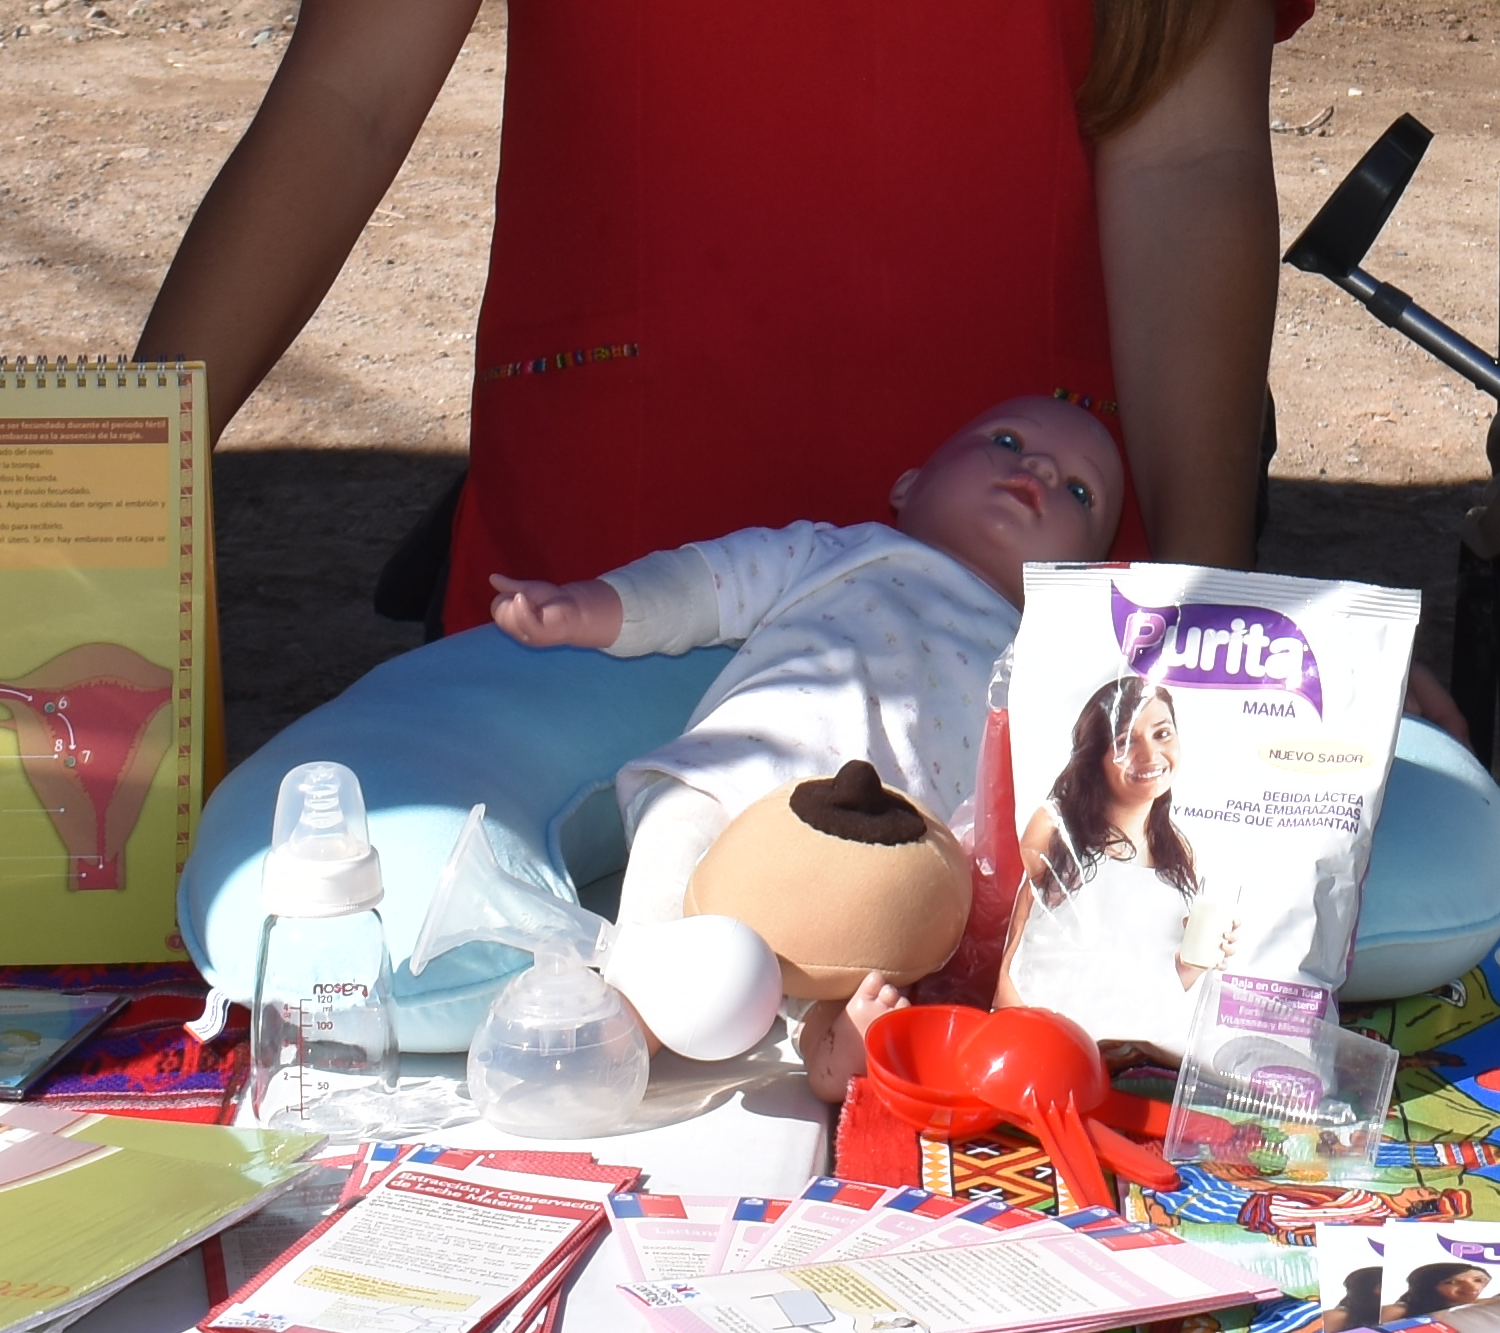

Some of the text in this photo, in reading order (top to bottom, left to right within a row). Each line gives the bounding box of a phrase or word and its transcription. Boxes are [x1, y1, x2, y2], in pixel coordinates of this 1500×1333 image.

[1121, 612, 1306, 685] Purita
[1242, 700, 1296, 718] MAMÁ
[1268, 748, 1315, 762] NUEVO
[1262, 790, 1365, 806] BEBIDA LÁCTEA
[1226, 799, 1362, 821] PARA EMBARAZADAS
[1183, 806, 1359, 835] MADRES QUE AMAMANTAN
[317, 995, 333, 1004] 120
[317, 1021, 333, 1030] 100
[317, 1081, 330, 1091] 50
[390, 1179, 534, 1212] de Leche Materna
[400, 1171, 603, 1212] Extracción Conservación
